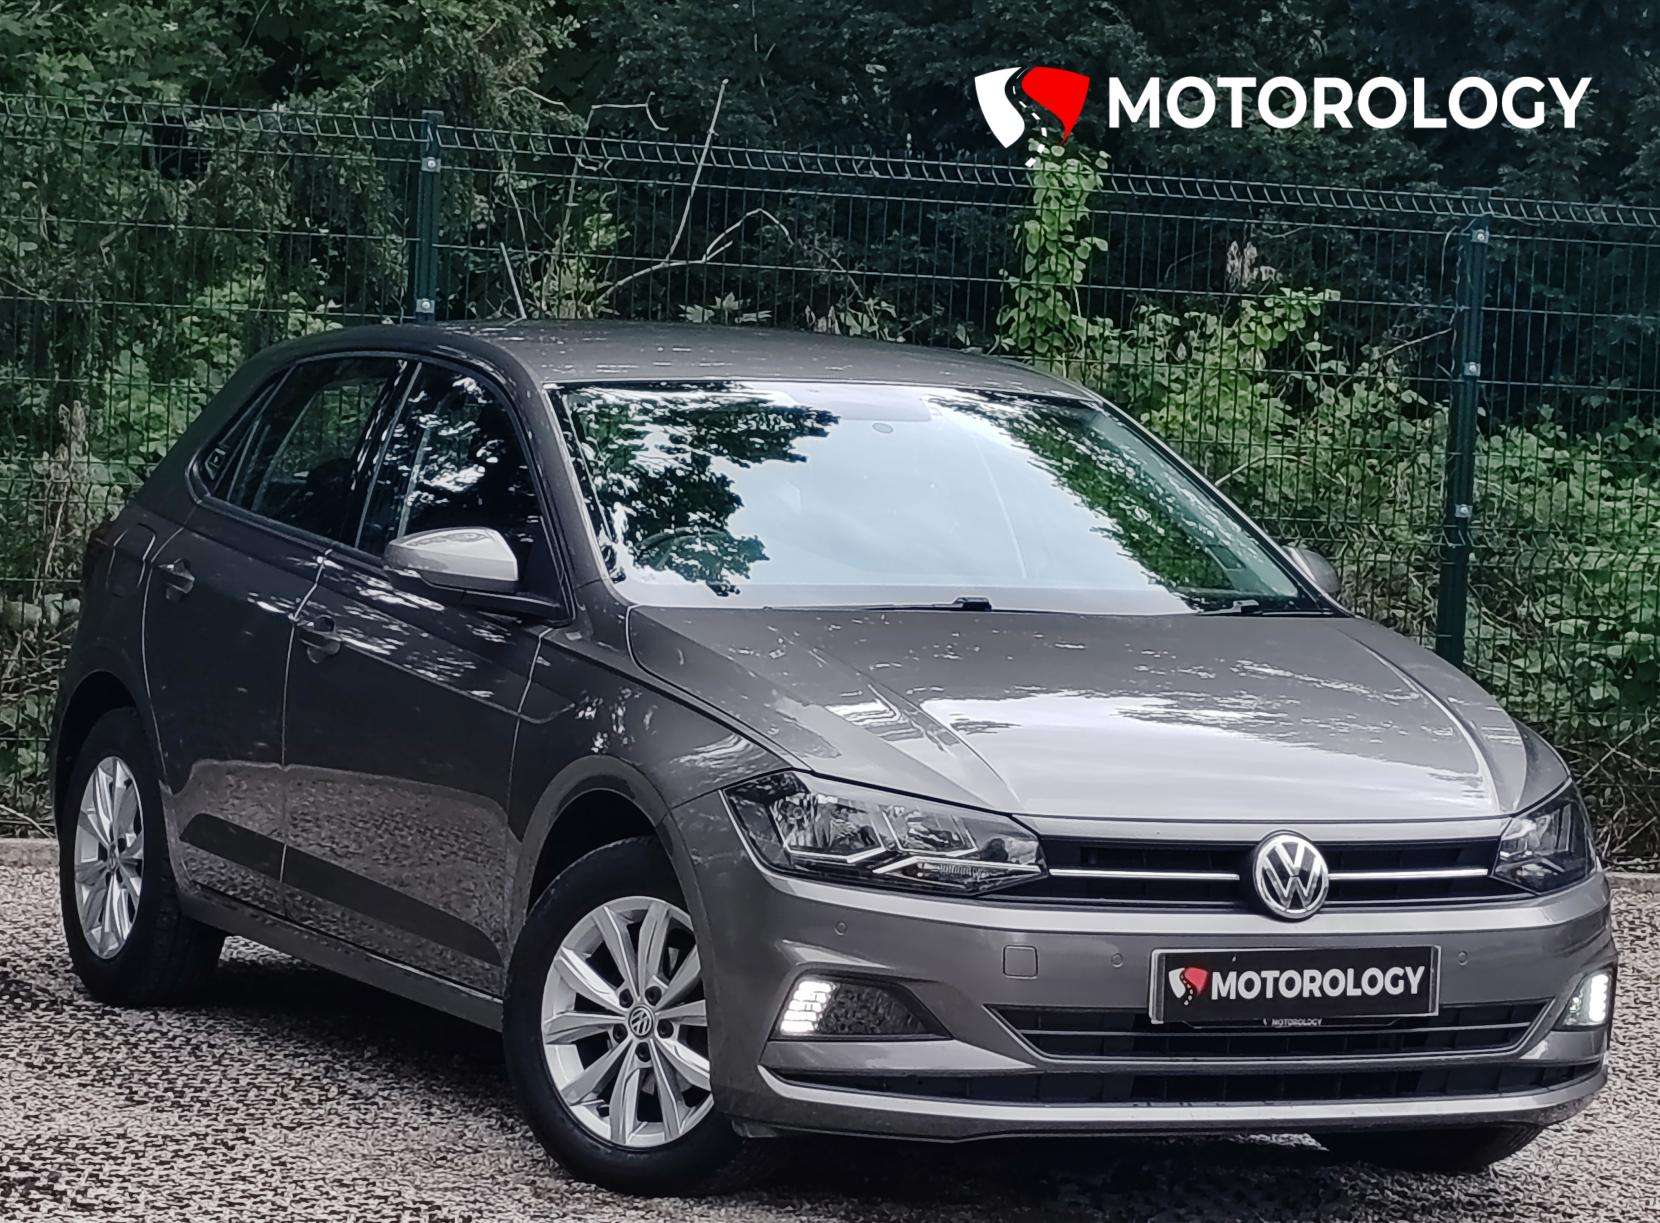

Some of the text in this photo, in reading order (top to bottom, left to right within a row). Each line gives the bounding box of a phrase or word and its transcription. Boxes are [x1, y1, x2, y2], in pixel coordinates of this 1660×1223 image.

[1257, 835, 1328, 918] VW
[1211, 966, 1425, 1000] MOTOROLOGY
[1271, 1017, 1323, 1027] MOTOROLOGY
